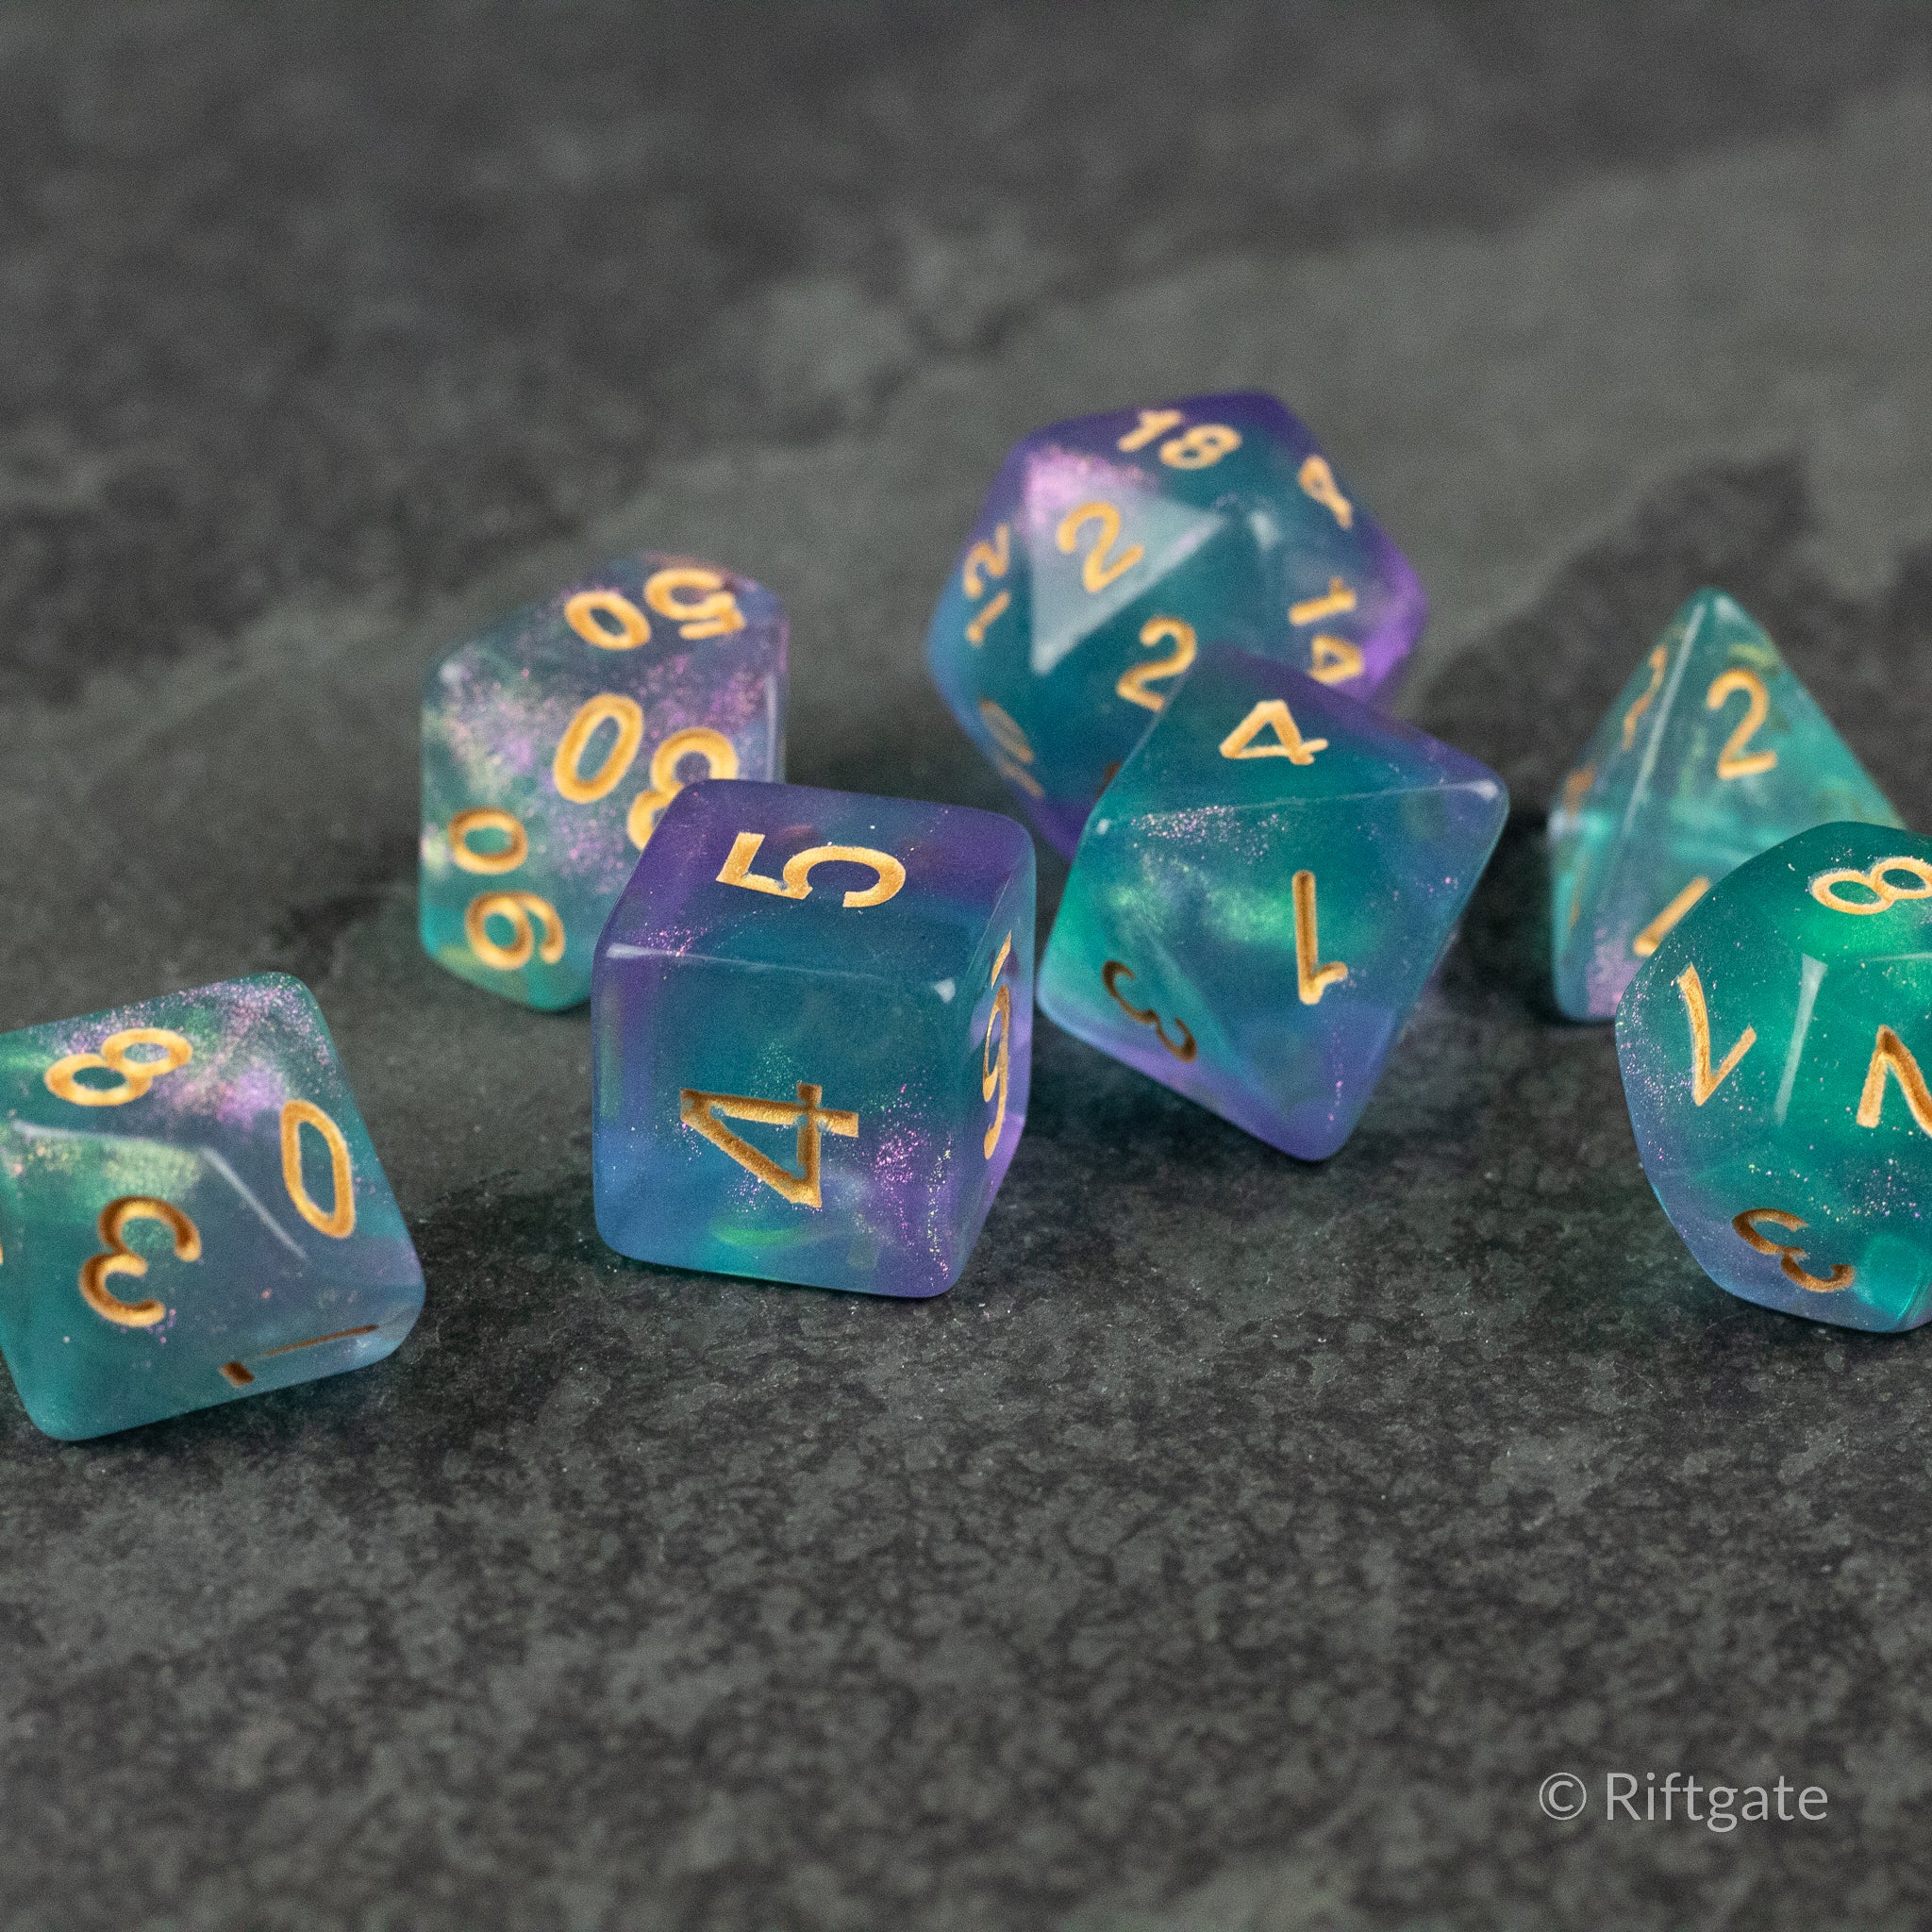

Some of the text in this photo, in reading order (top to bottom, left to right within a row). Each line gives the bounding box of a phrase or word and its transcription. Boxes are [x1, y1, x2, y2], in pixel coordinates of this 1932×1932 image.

[1118, 408, 1242, 470] 18
[962, 523, 1010, 645] 12
[1057, 501, 1144, 593] 2
[564, 568, 745, 651] 50
[1219, 700, 1329, 766] 4
[1706, 668, 1777, 780] 2
[715, 831, 907, 909] 5
[1809, 857, 1932, 915] 8
[1291, 870, 1349, 1006] 1
[1101, 959, 1198, 1063] 3
[43, 1027, 194, 1108] 8
[280, 1099, 357, 1240] 0
[679, 1082, 859, 1208] 4
[78, 1195, 202, 1328] 3
[1732, 1207, 1856, 1293] 3
